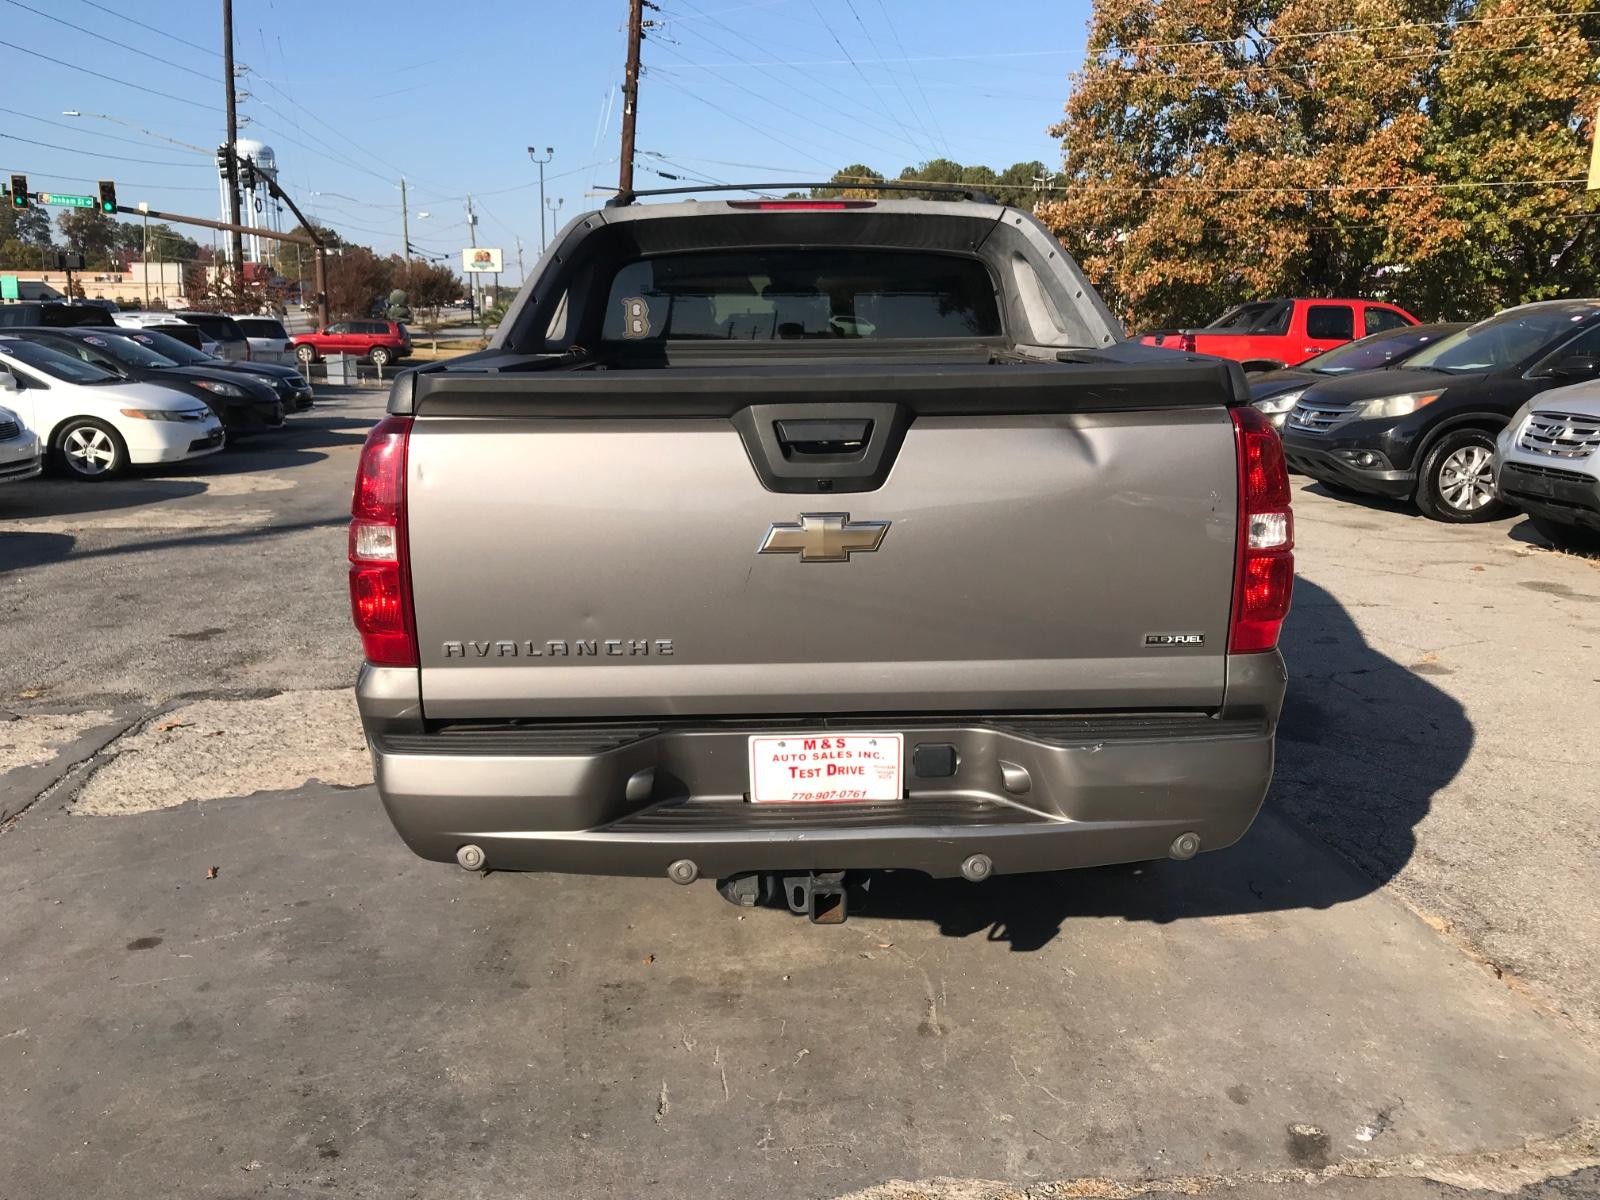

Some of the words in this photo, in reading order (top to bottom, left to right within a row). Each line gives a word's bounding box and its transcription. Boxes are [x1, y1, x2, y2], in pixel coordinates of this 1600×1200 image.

[442, 639, 674, 658] AVALANCHE
[804, 739, 816, 751] M
[820, 738, 832, 749] &
[836, 738, 846, 749] S
[772, 753, 807, 762] AUTO
[812, 751, 853, 761] SALES
[858, 751, 885, 760] INC.
[791, 790, 867, 801] 770-907-0761
